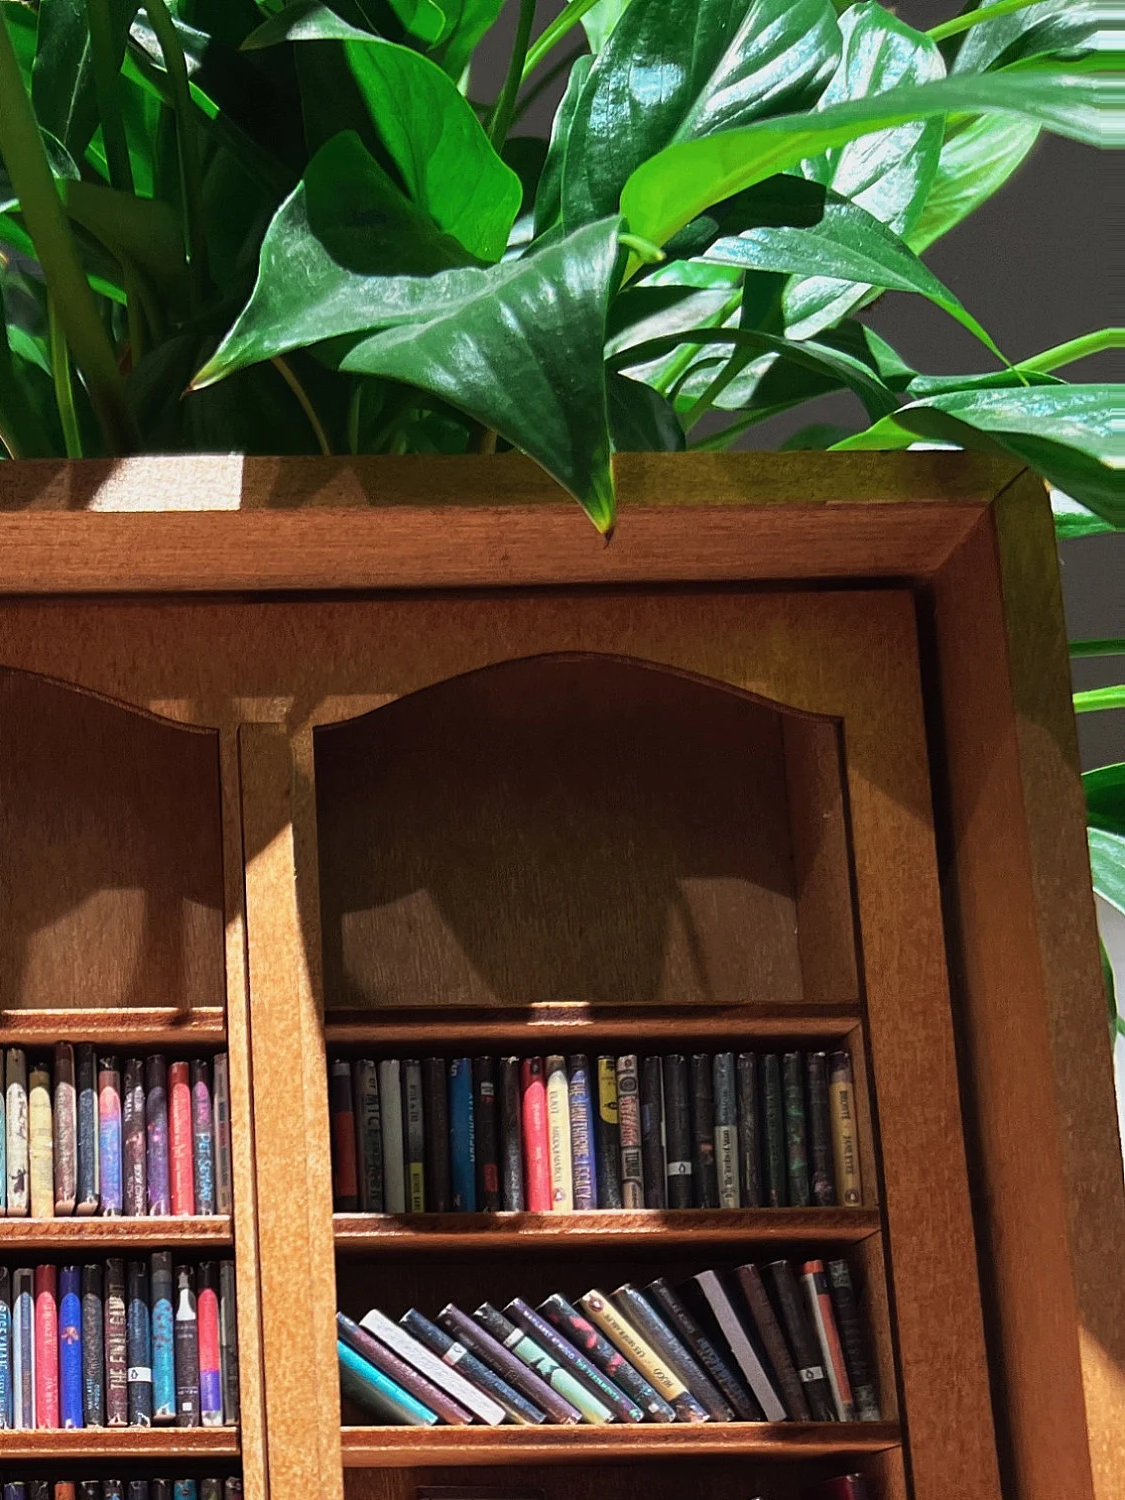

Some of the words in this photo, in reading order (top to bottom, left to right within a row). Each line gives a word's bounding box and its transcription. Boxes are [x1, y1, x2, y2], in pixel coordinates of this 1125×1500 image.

[570, 1079, 586, 1096] THE
[550, 1091, 560, 1114] ELIOT
[571, 1100, 589, 1157] HAWTHORNE
[196, 1133, 211, 1156] PET
[574, 1161, 592, 1199] LEGACY
[109, 1333, 126, 1363] FINAL
[110, 1368, 126, 1390] THE
